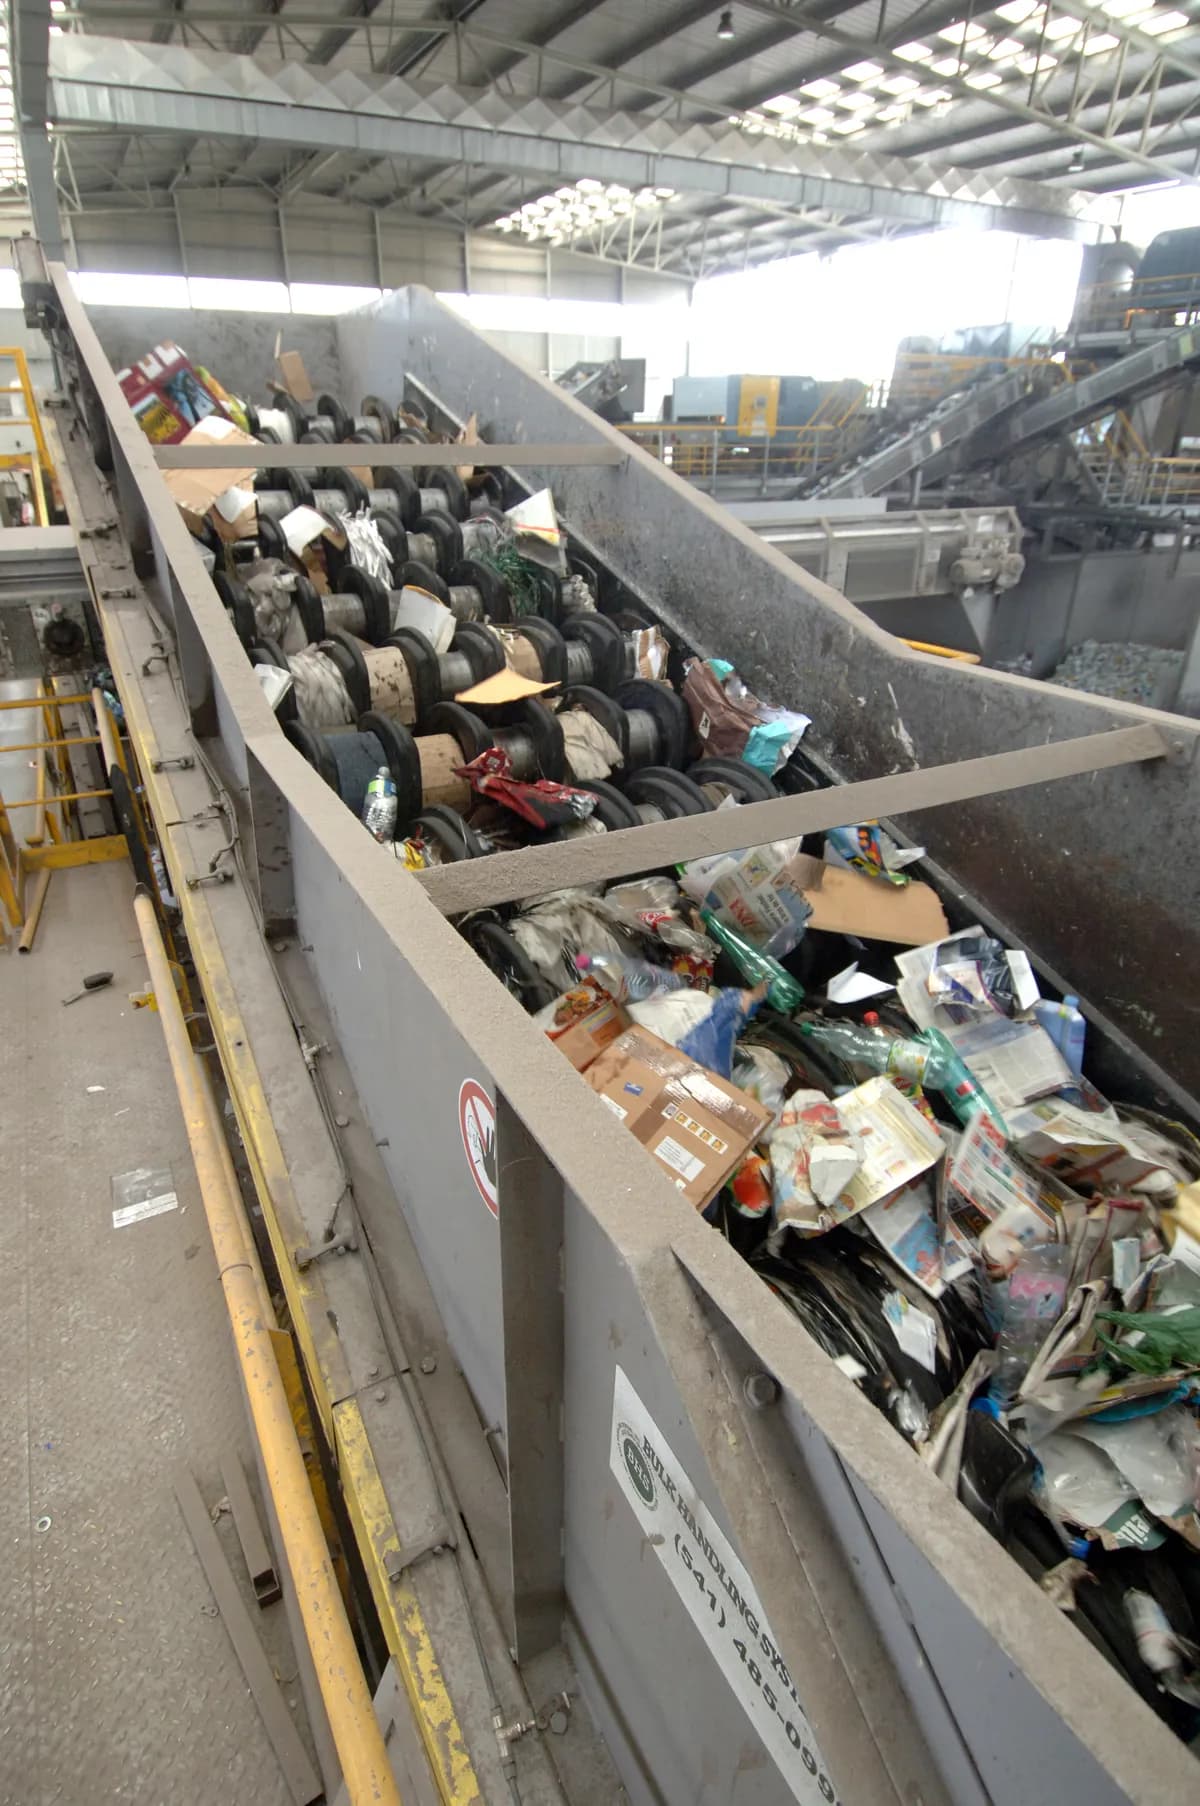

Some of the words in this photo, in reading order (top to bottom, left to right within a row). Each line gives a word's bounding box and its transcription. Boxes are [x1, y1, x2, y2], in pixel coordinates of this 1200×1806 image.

[625, 1447, 651, 1490] BHS
[643, 1435, 677, 1502] BULK
[677, 1494, 760, 1639] HANDLING
[760, 1633, 808, 1720] SYS
[674, 1533, 726, 1628] (541)
[733, 1638, 842, 1806] 485-099
